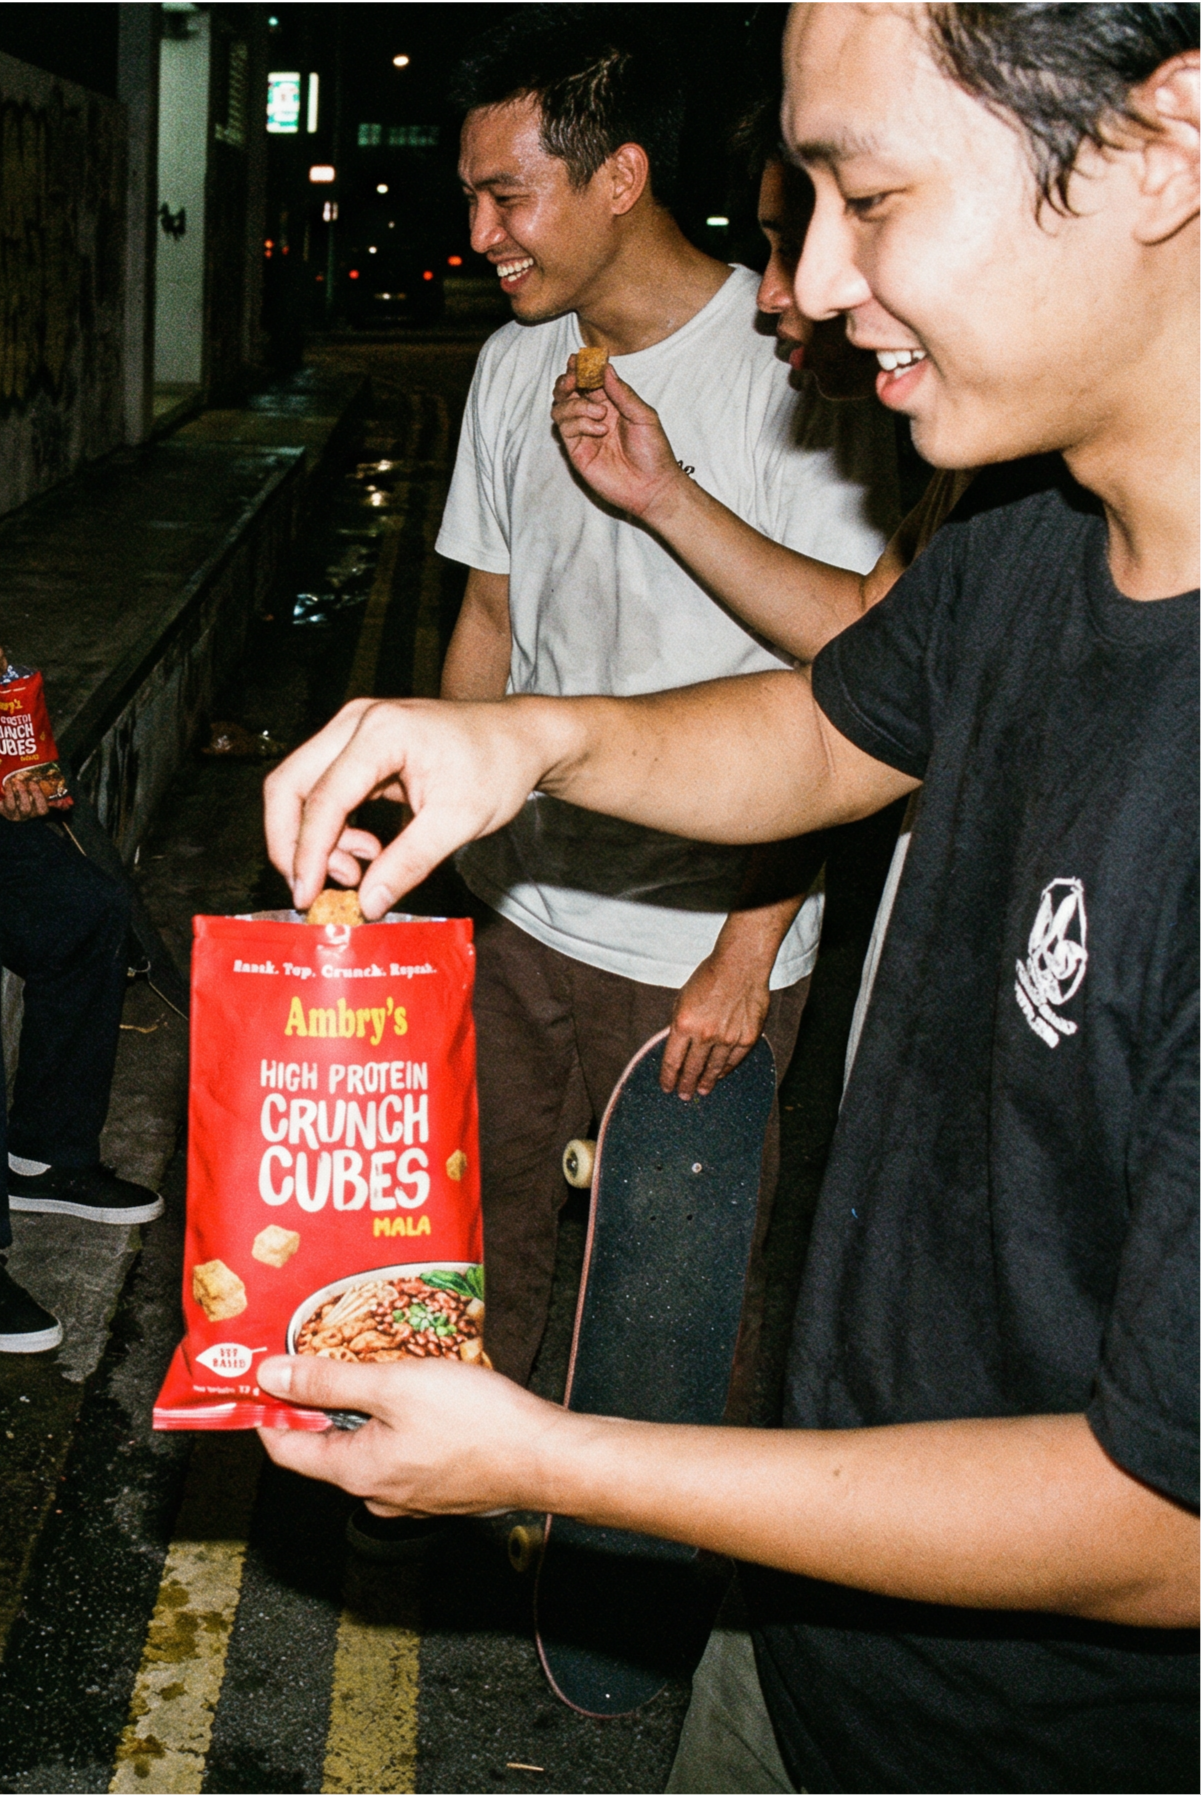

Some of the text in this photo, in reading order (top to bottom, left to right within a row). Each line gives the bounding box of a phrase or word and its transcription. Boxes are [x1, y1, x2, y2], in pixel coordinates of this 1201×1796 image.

[284, 996, 408, 1046] Ambry's
[260, 1059, 428, 1095] HIGH PROTEIN
[260, 1093, 429, 1150] CRUNCH
[259, 1145, 430, 1212] CUBES
[373, 1215, 431, 1237] MALA
